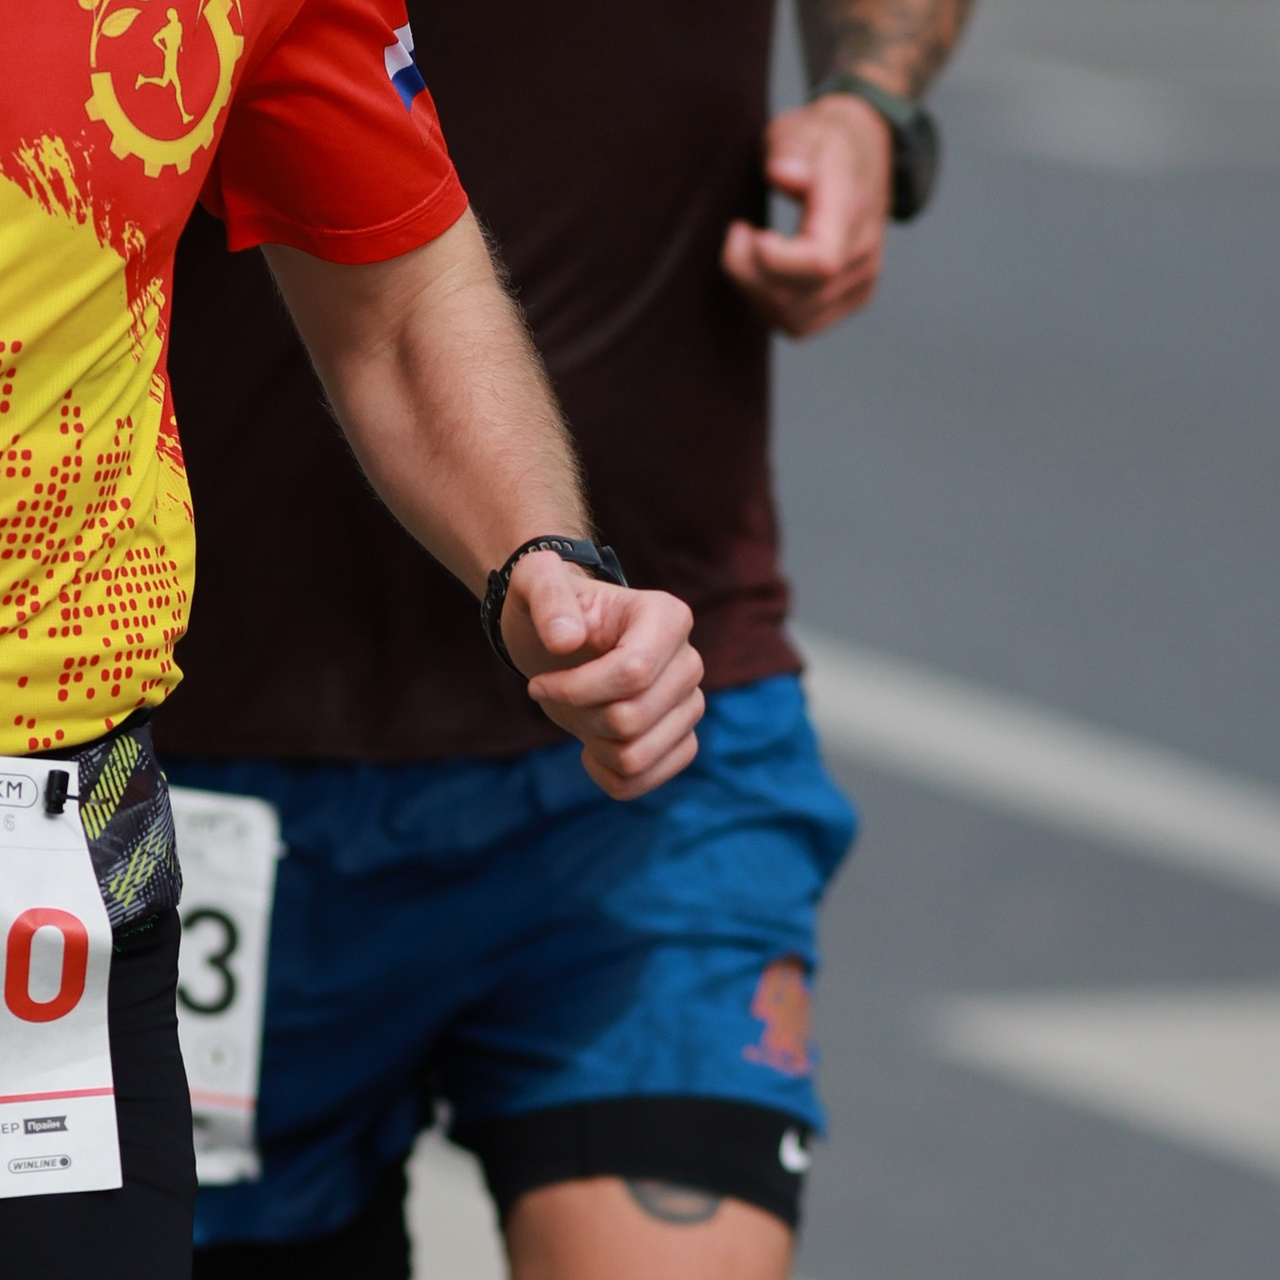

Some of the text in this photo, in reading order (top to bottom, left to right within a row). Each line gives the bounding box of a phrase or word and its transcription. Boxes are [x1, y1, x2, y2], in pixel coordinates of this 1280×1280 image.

[177, 906, 240, 1014] 3
[27, 1120, 61, 1132] Прайм
[13, 1159, 57, 1170] WINLINE
